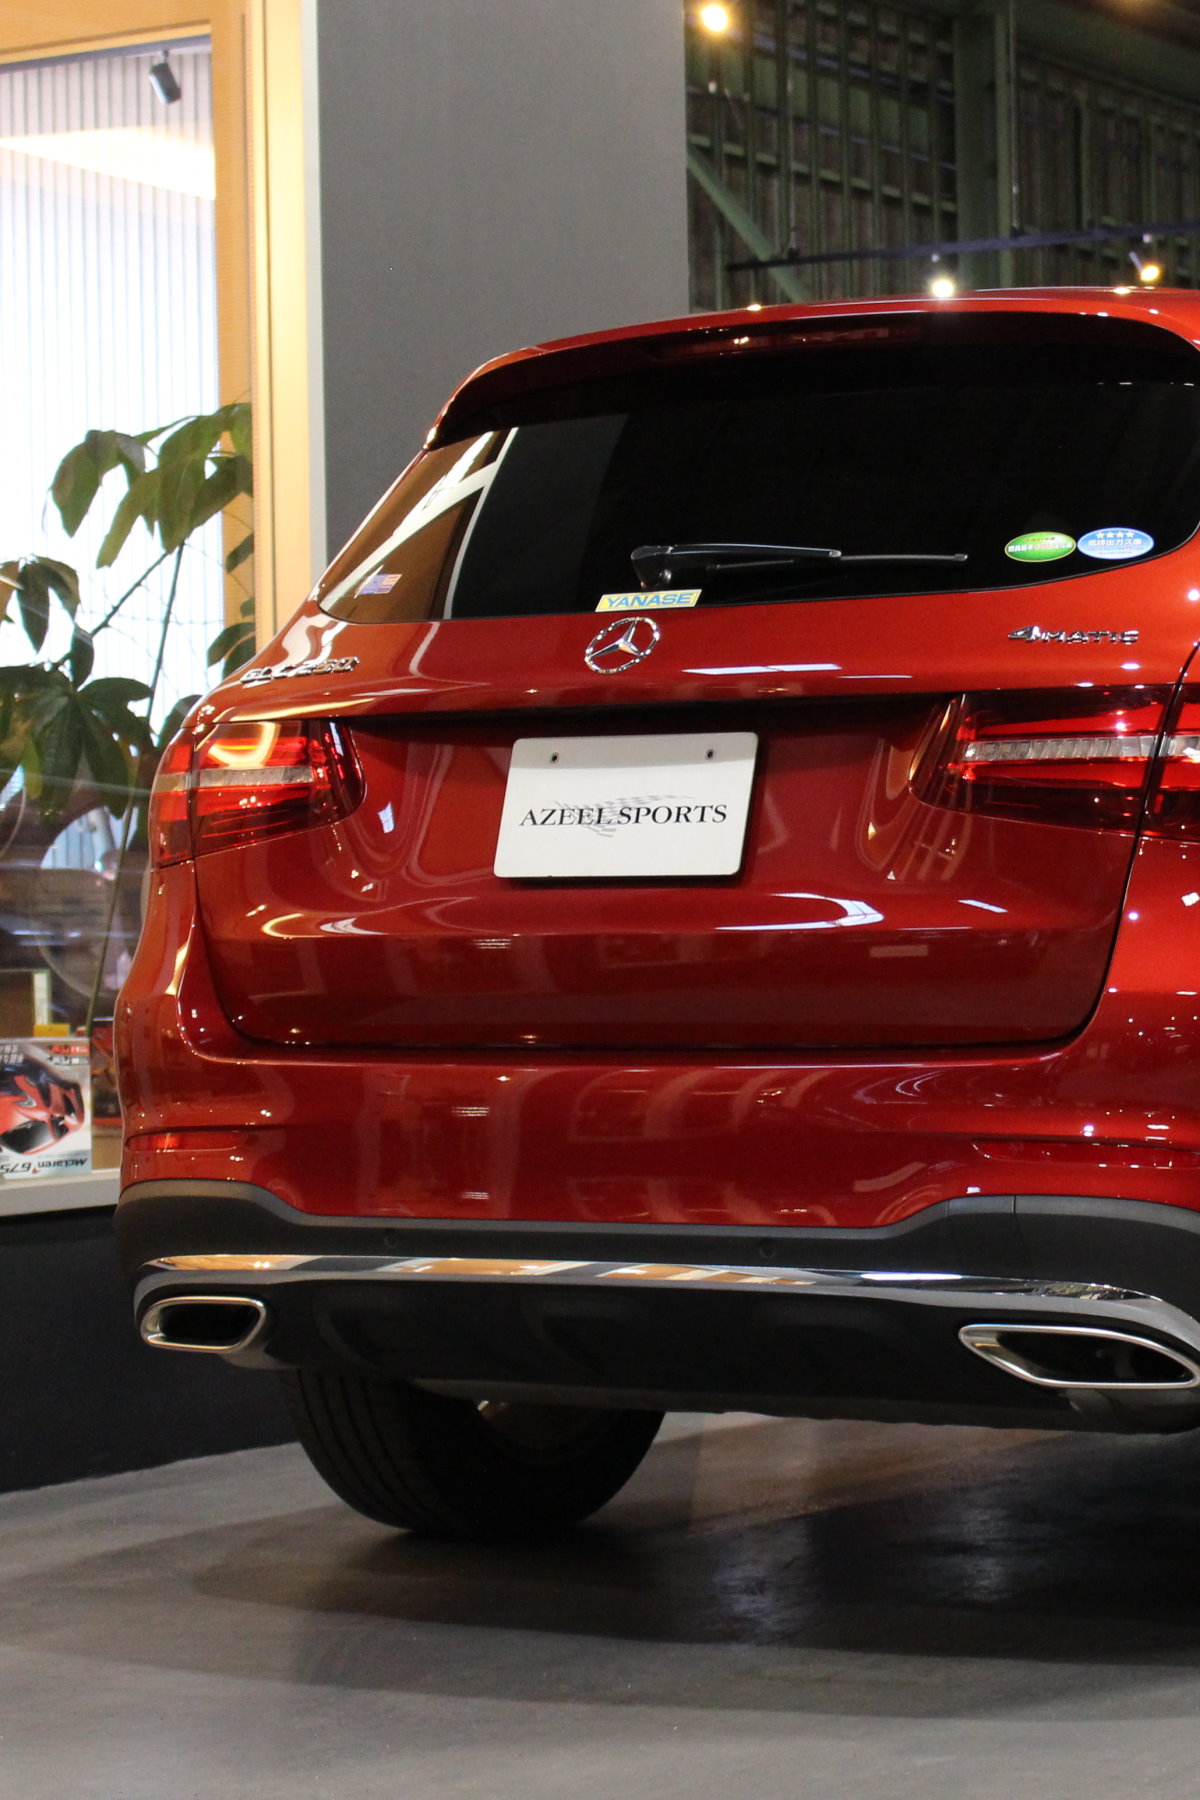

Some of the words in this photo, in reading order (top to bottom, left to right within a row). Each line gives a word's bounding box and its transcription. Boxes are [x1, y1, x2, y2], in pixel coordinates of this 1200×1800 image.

[607, 592, 693, 608] YANASE
[1008, 625, 1140, 645] 4MATIC
[519, 808, 613, 827] AZEEL
[617, 805, 728, 825] SPORTS
